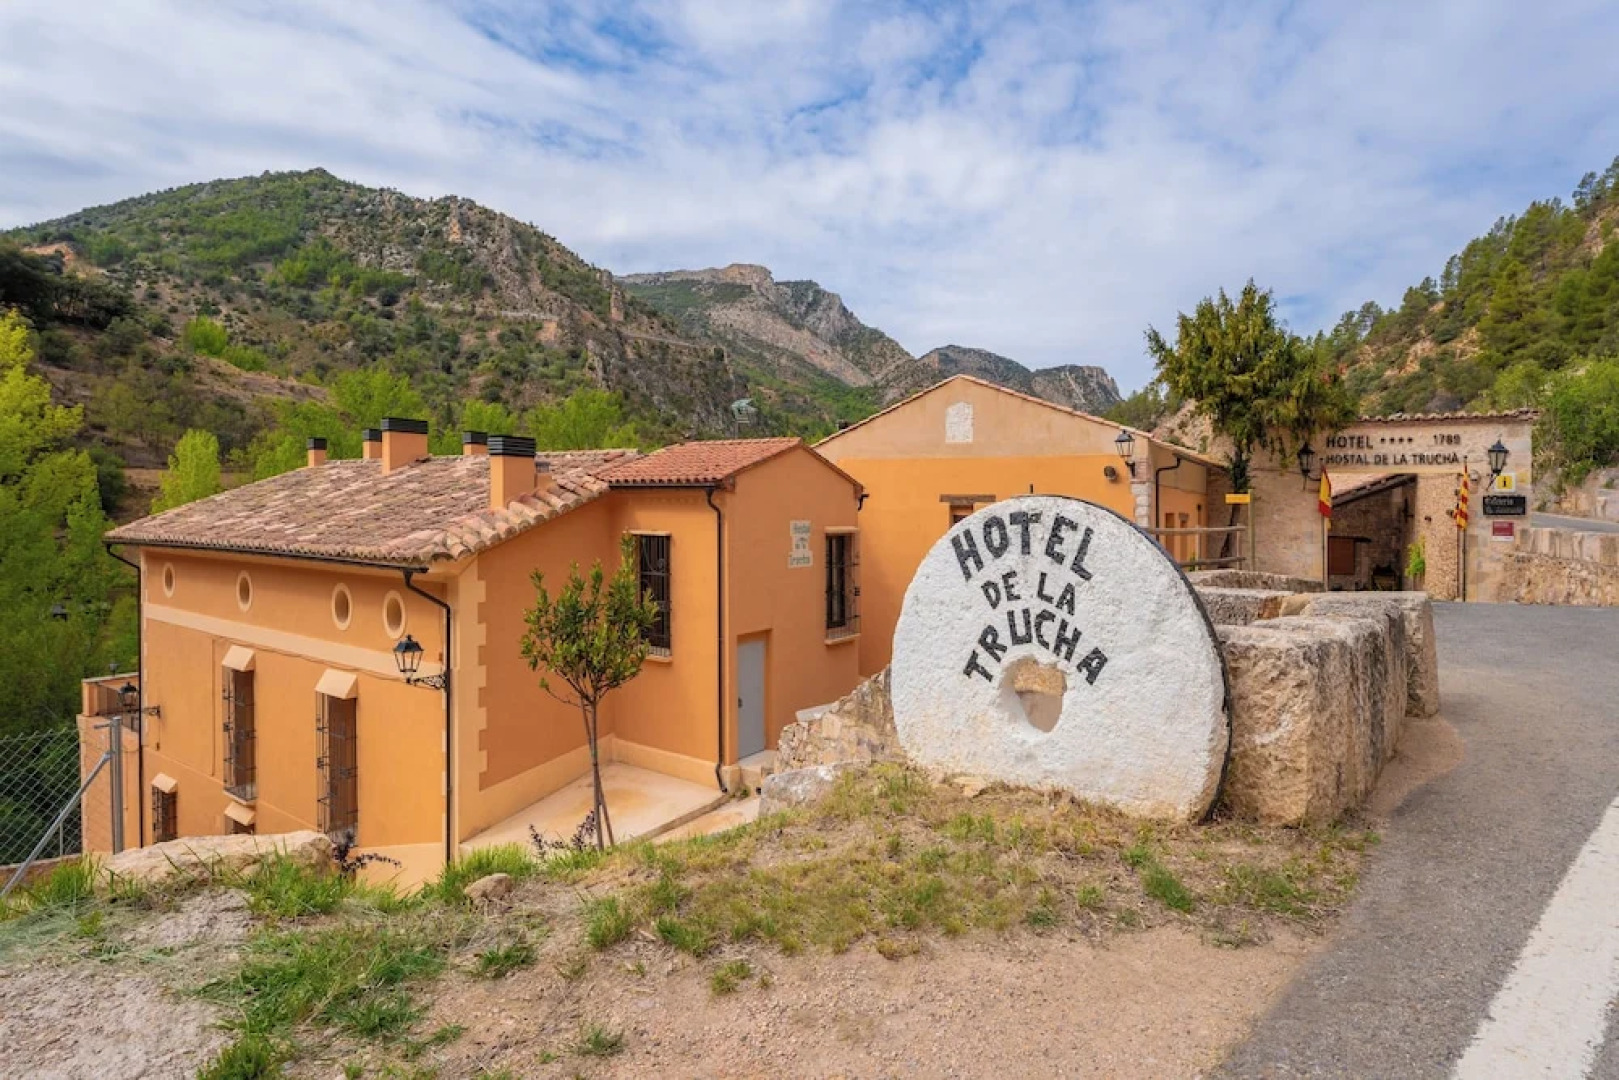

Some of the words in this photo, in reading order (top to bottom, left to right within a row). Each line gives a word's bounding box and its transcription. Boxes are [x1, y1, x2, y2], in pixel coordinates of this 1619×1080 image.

[1325, 453, 1370, 466] HOSTAL
[1374, 454, 1389, 466] DE
[1393, 453, 1408, 466] LA
[1412, 453, 1460, 466] TRUCHA
[1326, 435, 1374, 450] HOTEL
[951, 511, 1094, 581] HOTEL
[982, 570, 1021, 609] DE
[1037, 572, 1076, 616] LA
[963, 608, 1108, 685] TRUCHA
